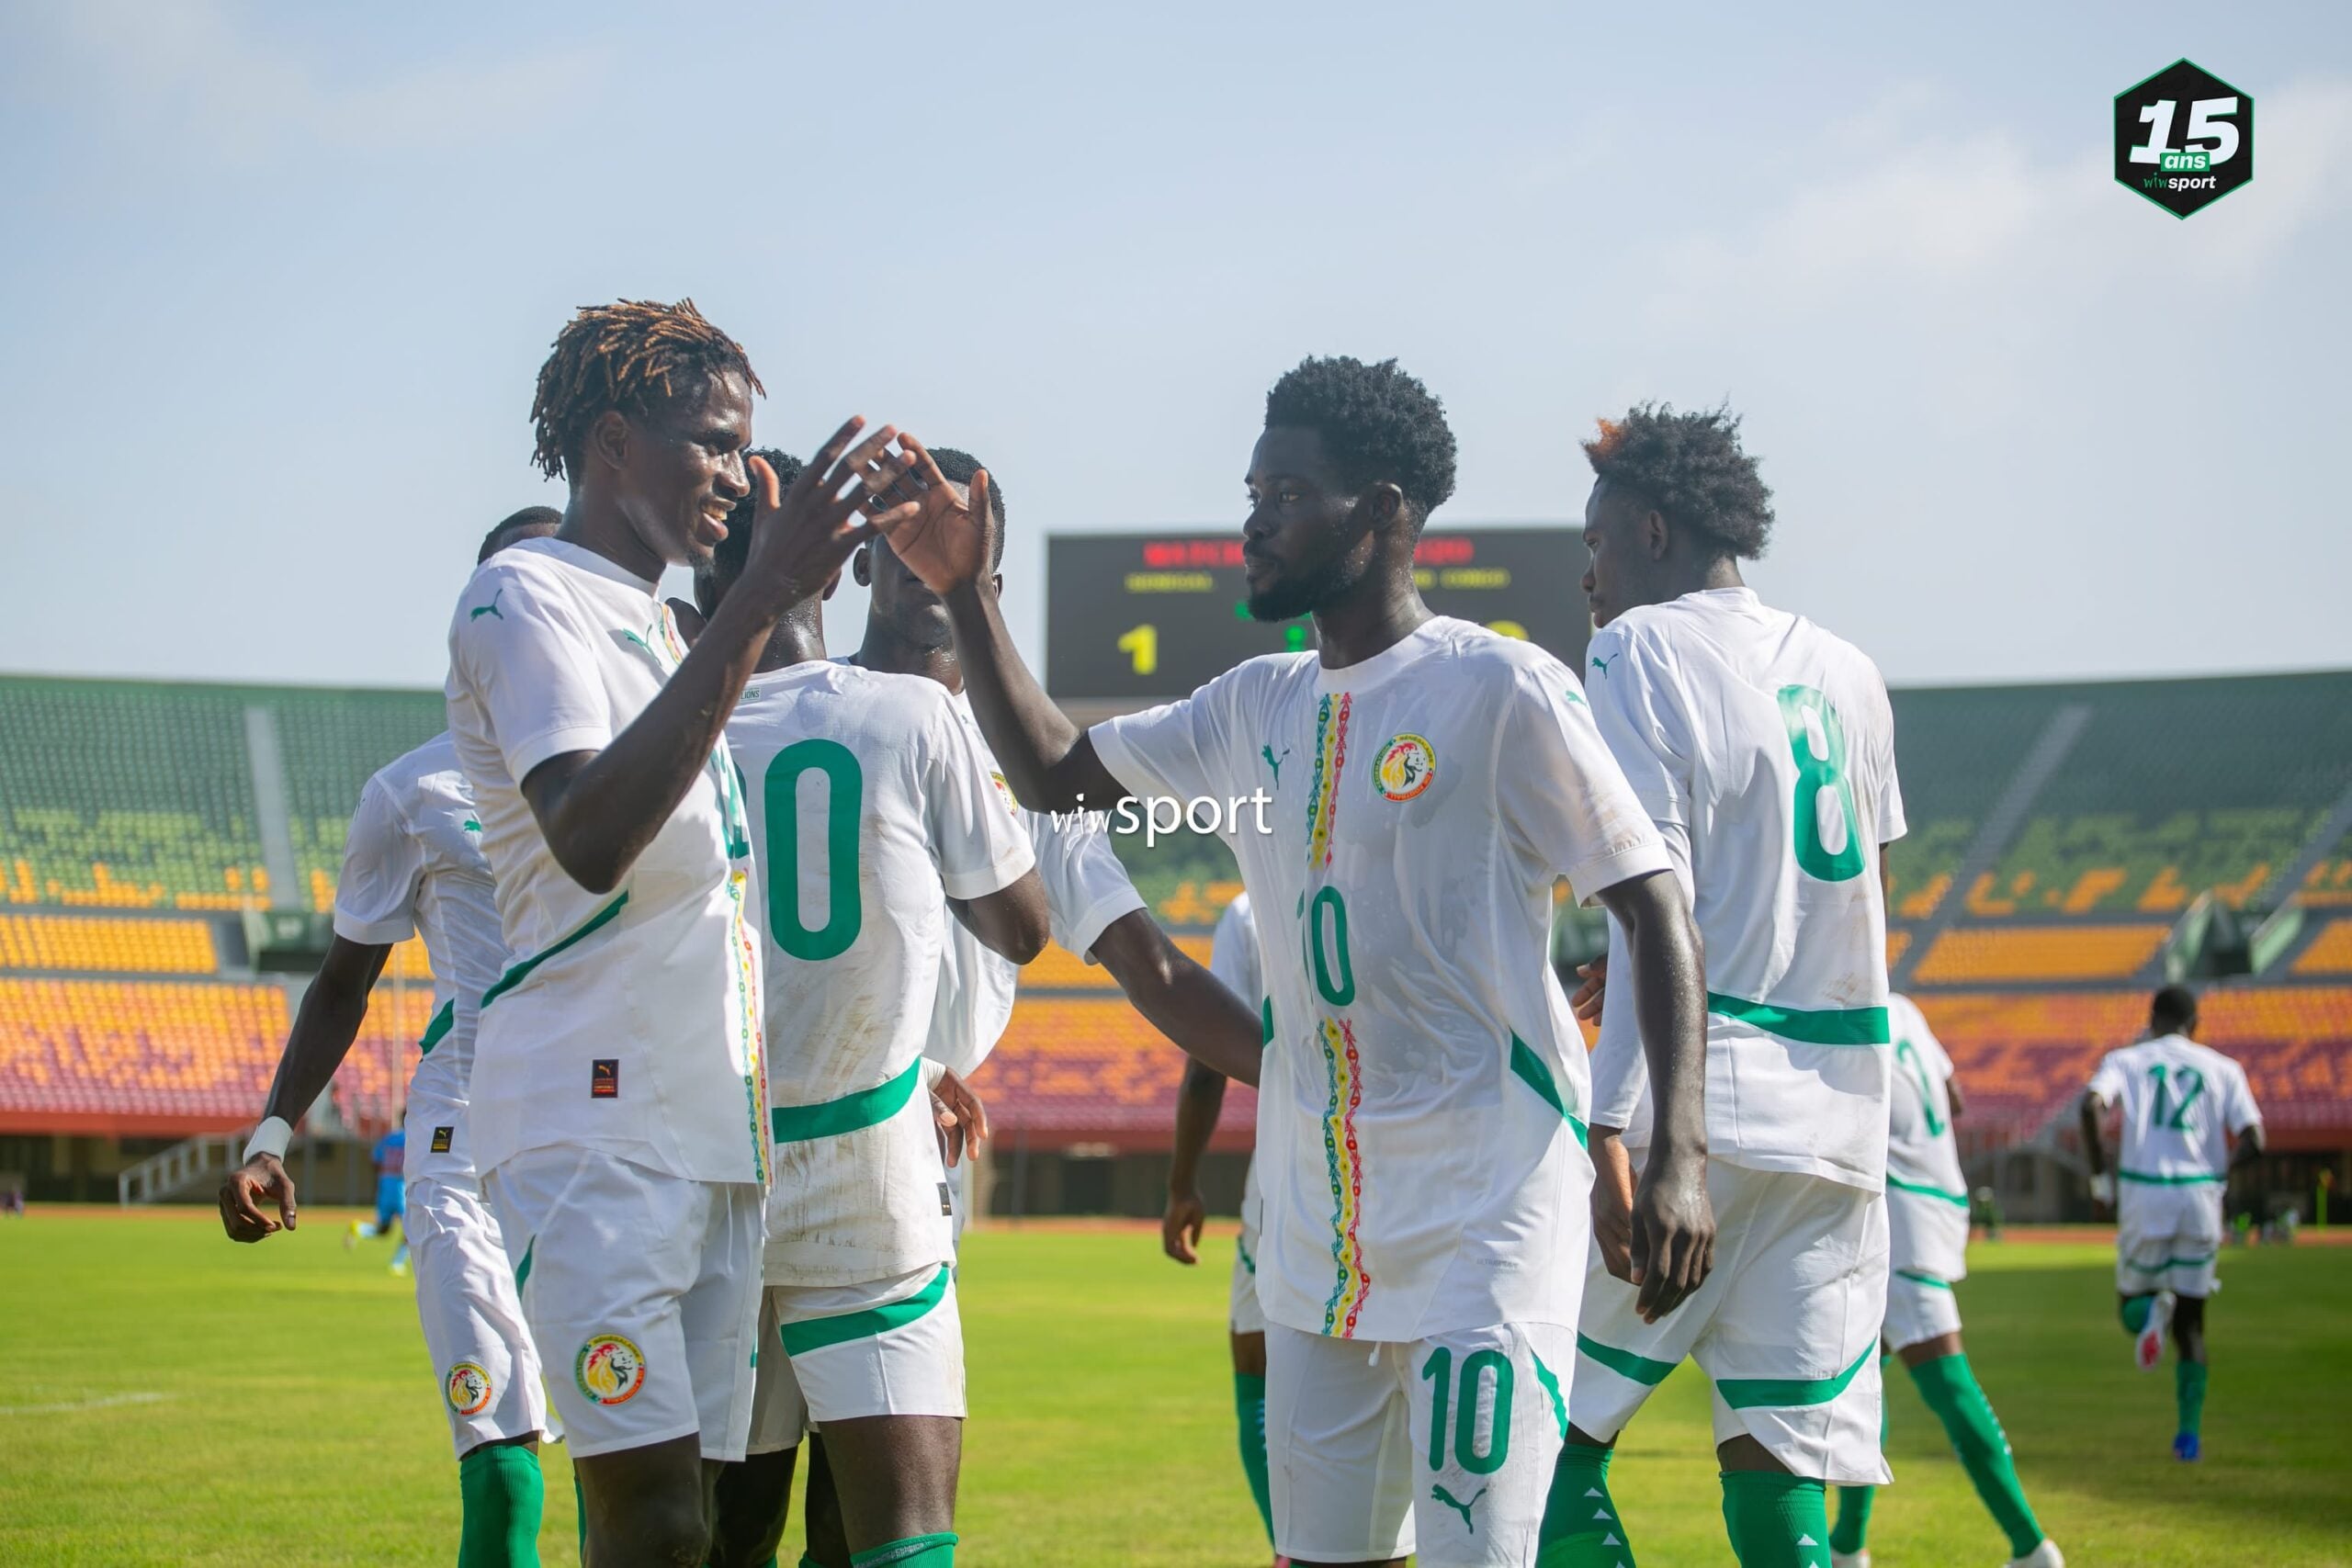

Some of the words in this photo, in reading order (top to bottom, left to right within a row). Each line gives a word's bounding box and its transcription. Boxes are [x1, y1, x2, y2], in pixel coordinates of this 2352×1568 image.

[741, 689, 760, 700] LIONS
[1118, 625, 1158, 674] 1
[1777, 683, 1866, 882] 8
[733, 739, 863, 961] 0
[2148, 1063, 2204, 1132] 12
[1421, 1347, 1514, 1475] 10
